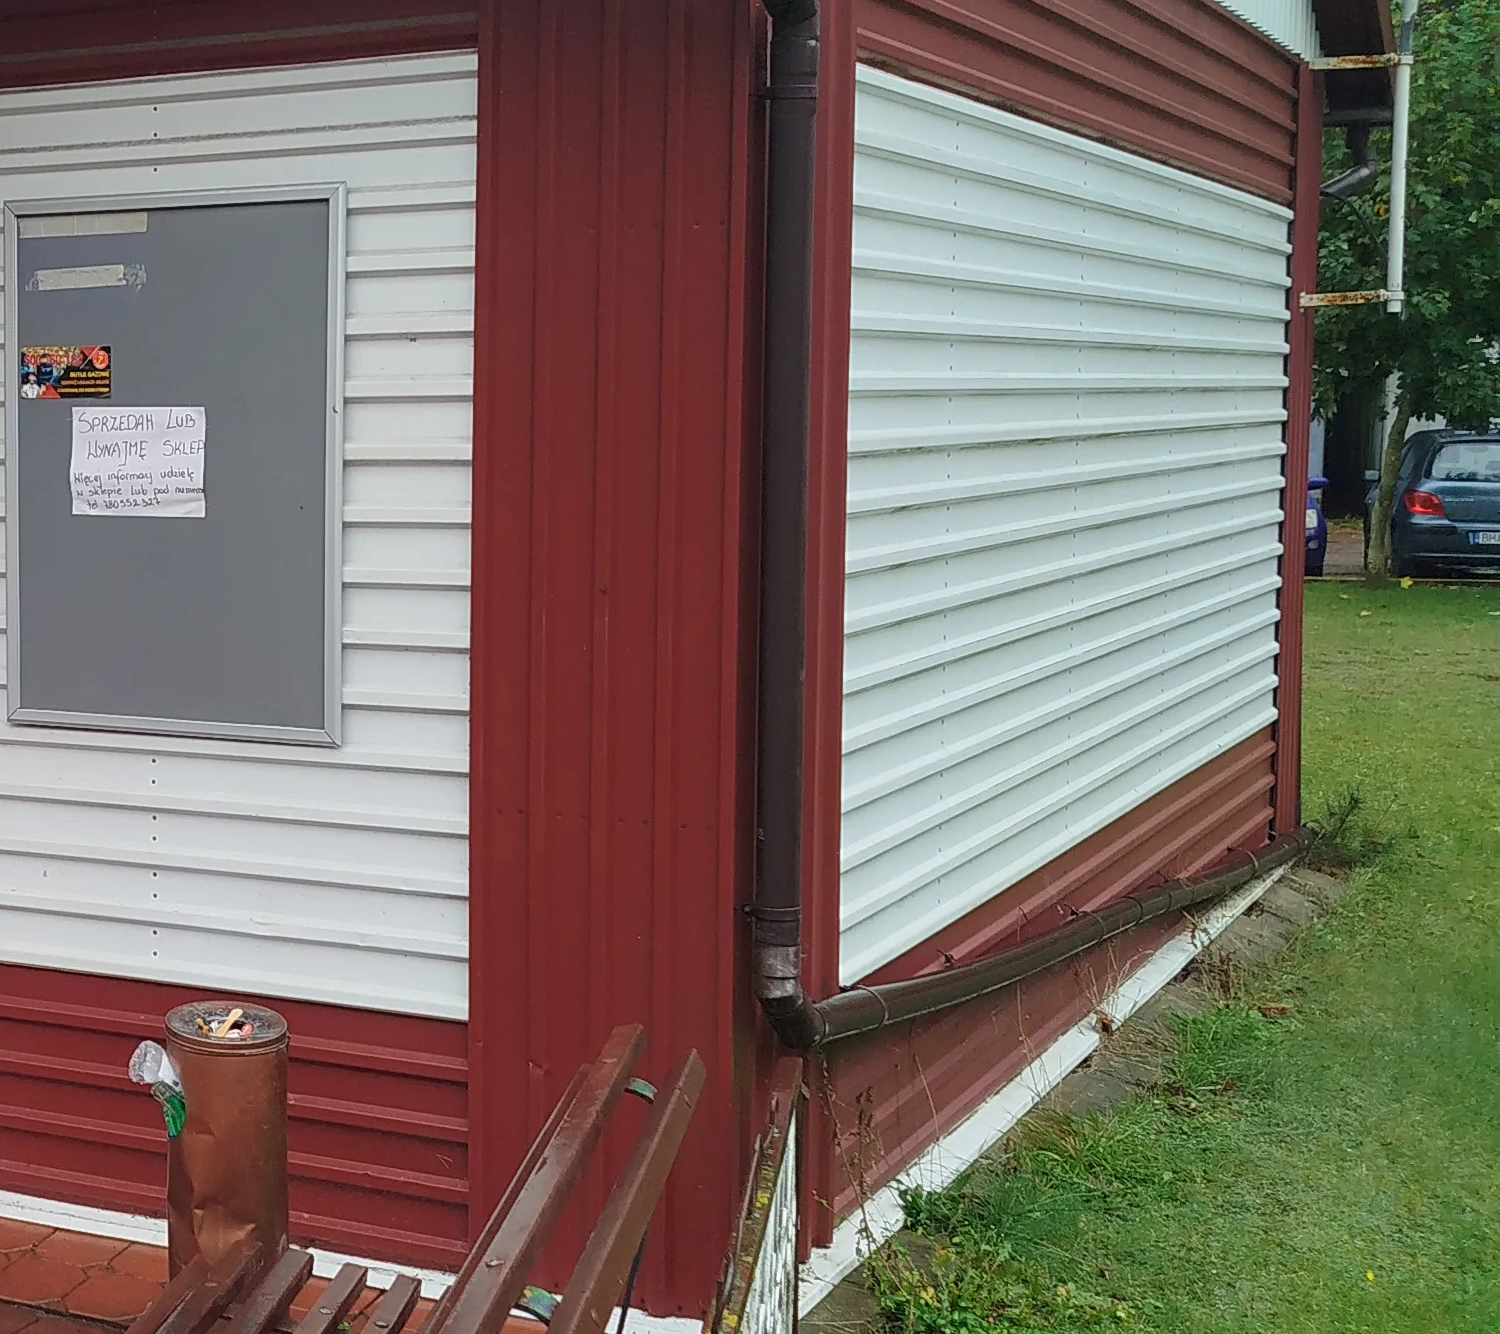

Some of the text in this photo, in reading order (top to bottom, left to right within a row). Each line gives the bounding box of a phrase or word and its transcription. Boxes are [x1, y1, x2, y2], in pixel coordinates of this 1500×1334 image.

[166, 409, 196, 429] LUB
[87, 439, 205, 467] WYNAJMĘ SKLEP
[88, 485, 123, 498] sklepie
[130, 484, 148, 496] lub
[153, 484, 170, 498] pod
